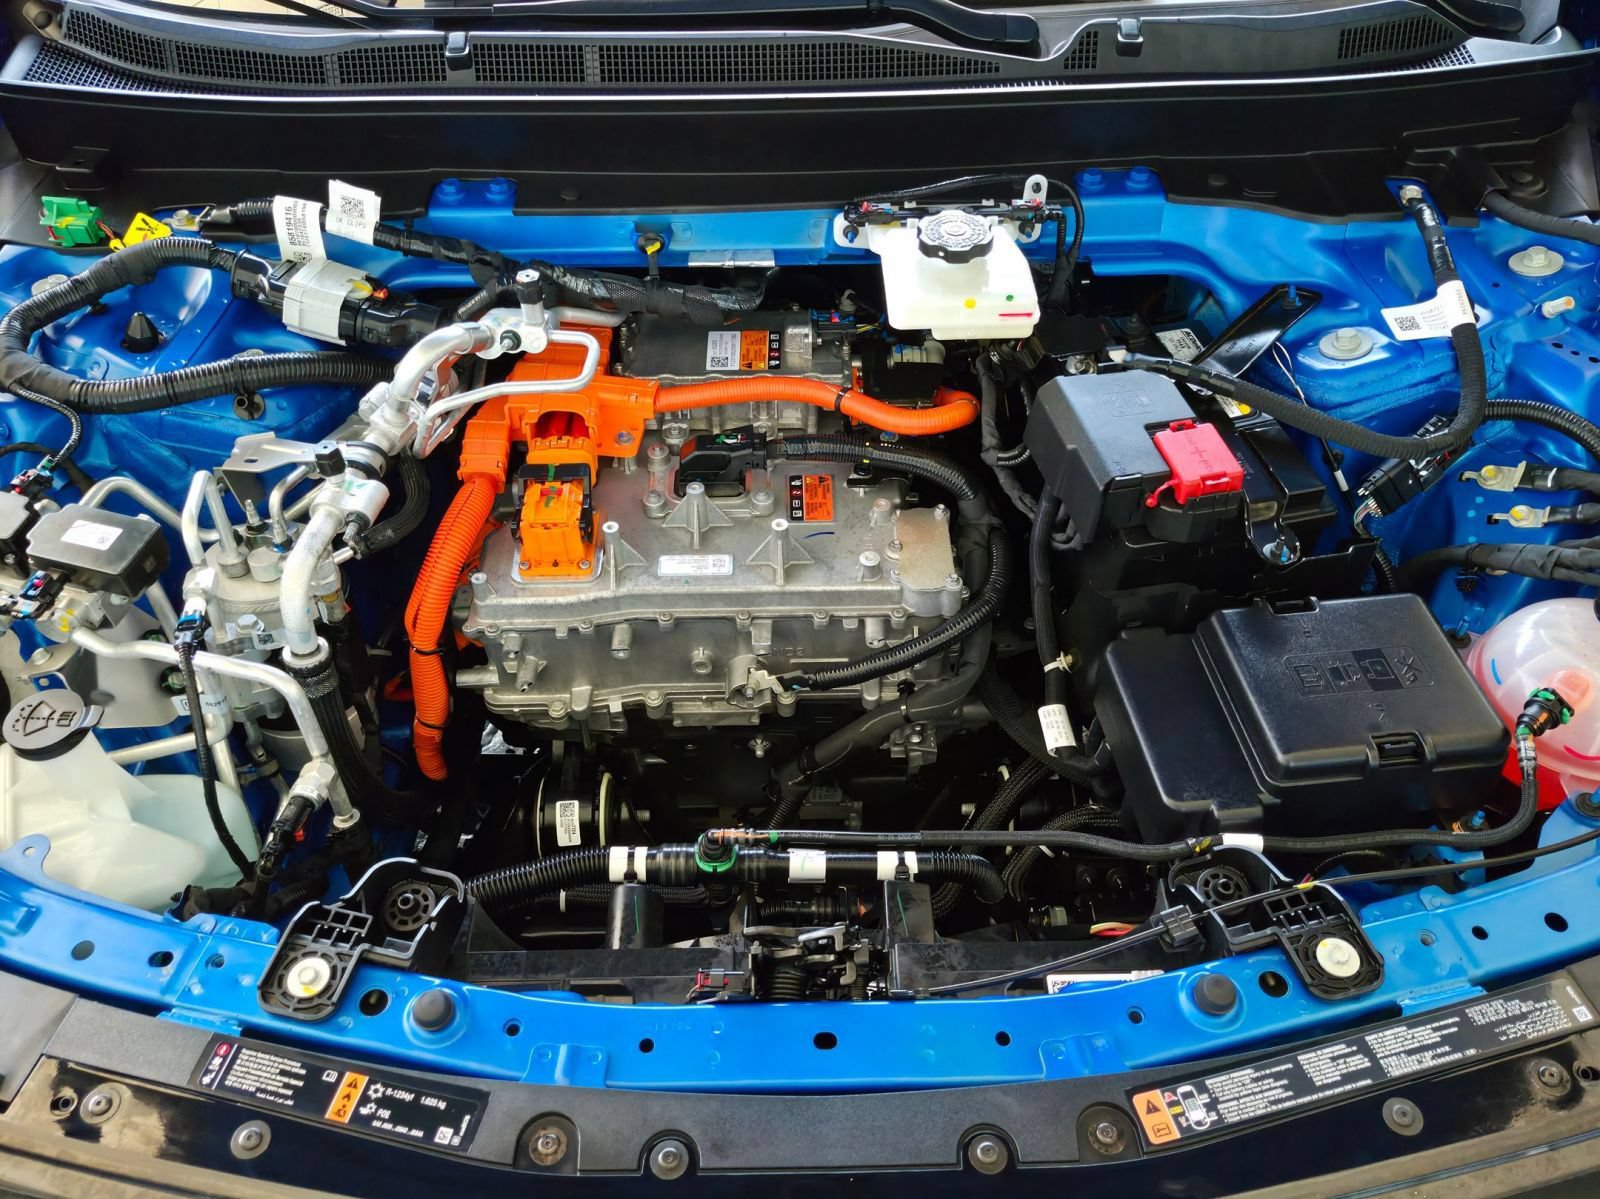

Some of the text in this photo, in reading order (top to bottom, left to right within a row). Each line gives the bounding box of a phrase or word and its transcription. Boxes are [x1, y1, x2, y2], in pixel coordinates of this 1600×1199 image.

[285, 206, 297, 246] 85819416
[385, 1088, 415, 1102] R-1234yf
[437, 1099, 447, 1110] kg
[376, 1109, 391, 1119] POE
